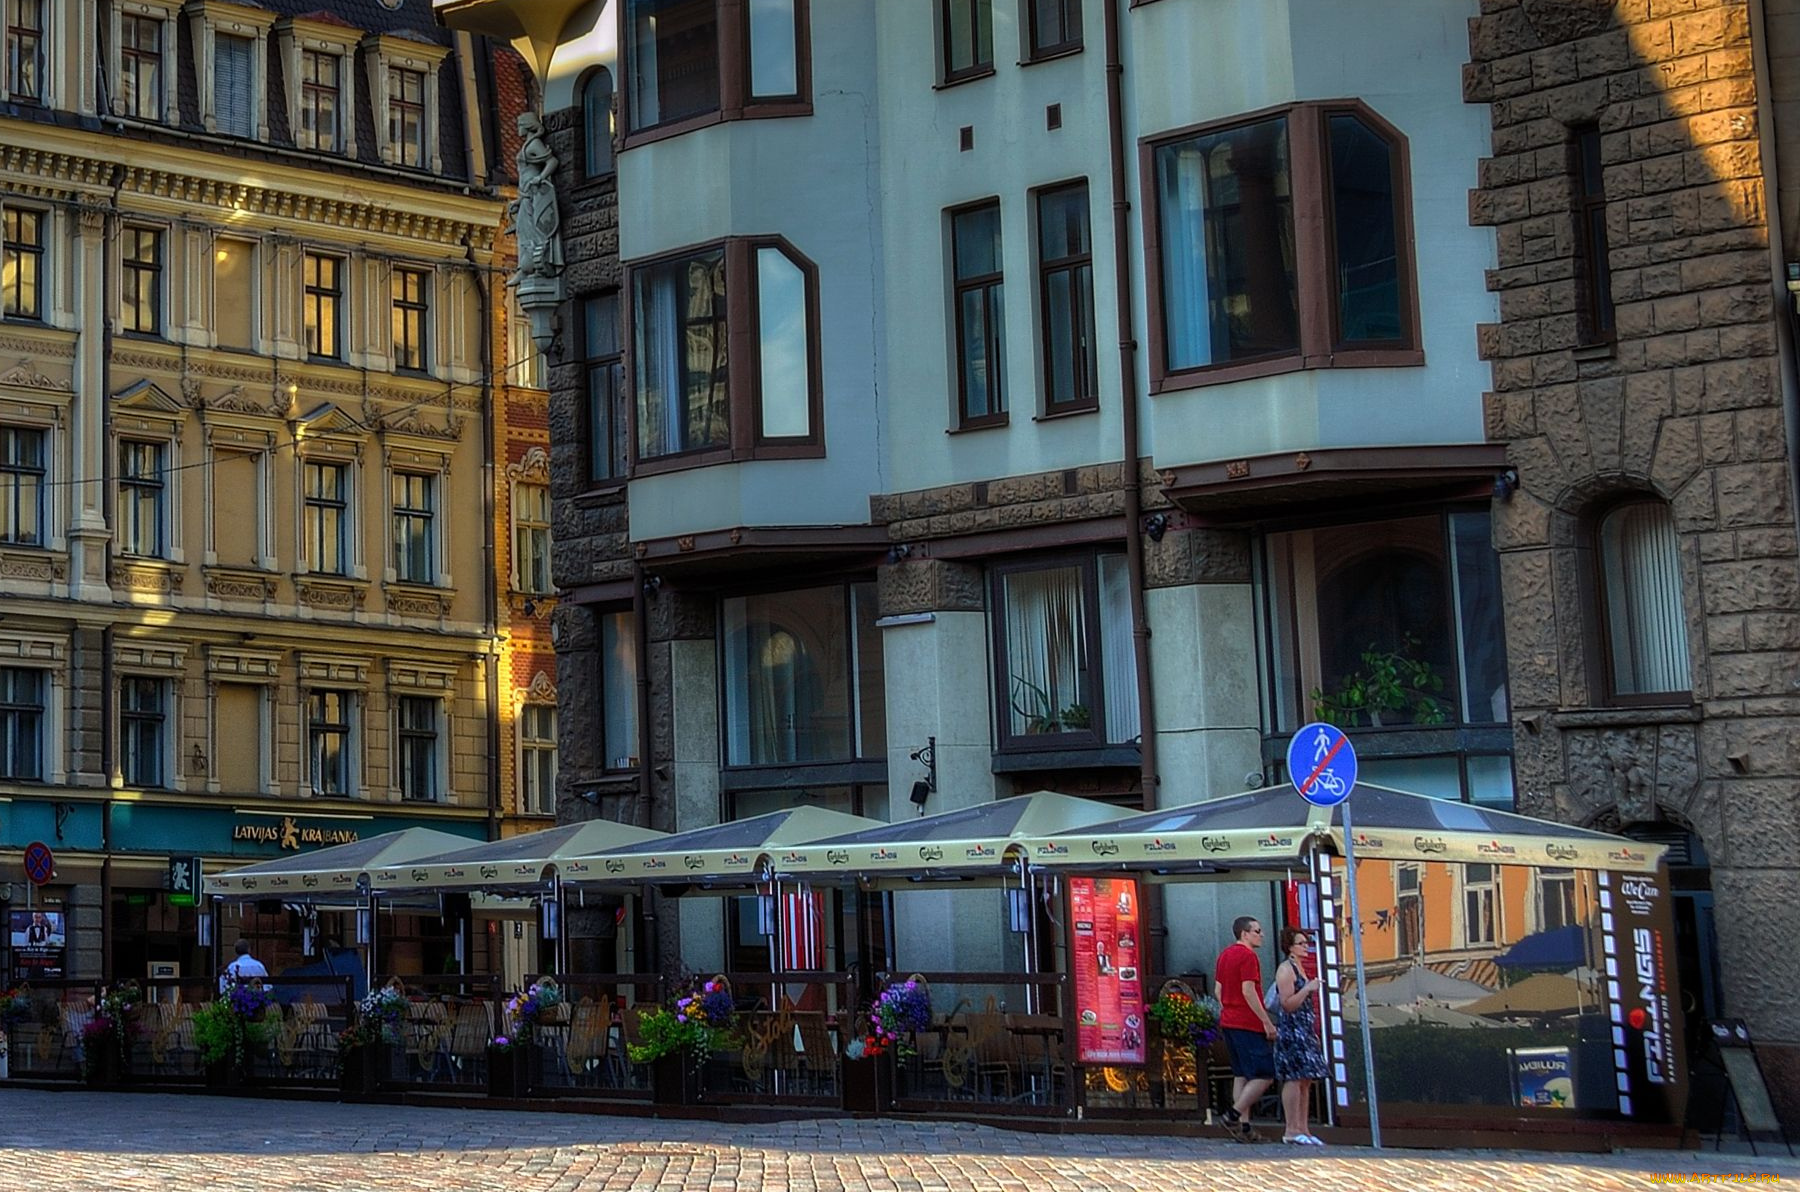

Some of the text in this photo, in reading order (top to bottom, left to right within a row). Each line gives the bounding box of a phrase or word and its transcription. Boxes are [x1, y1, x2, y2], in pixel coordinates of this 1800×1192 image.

[234, 826, 278, 844] LATVIJAS
[1092, 840, 1119, 856] Carlsberg
[1202, 836, 1230, 853] Carlsberg
[1415, 837, 1447, 854] Carlsberg
